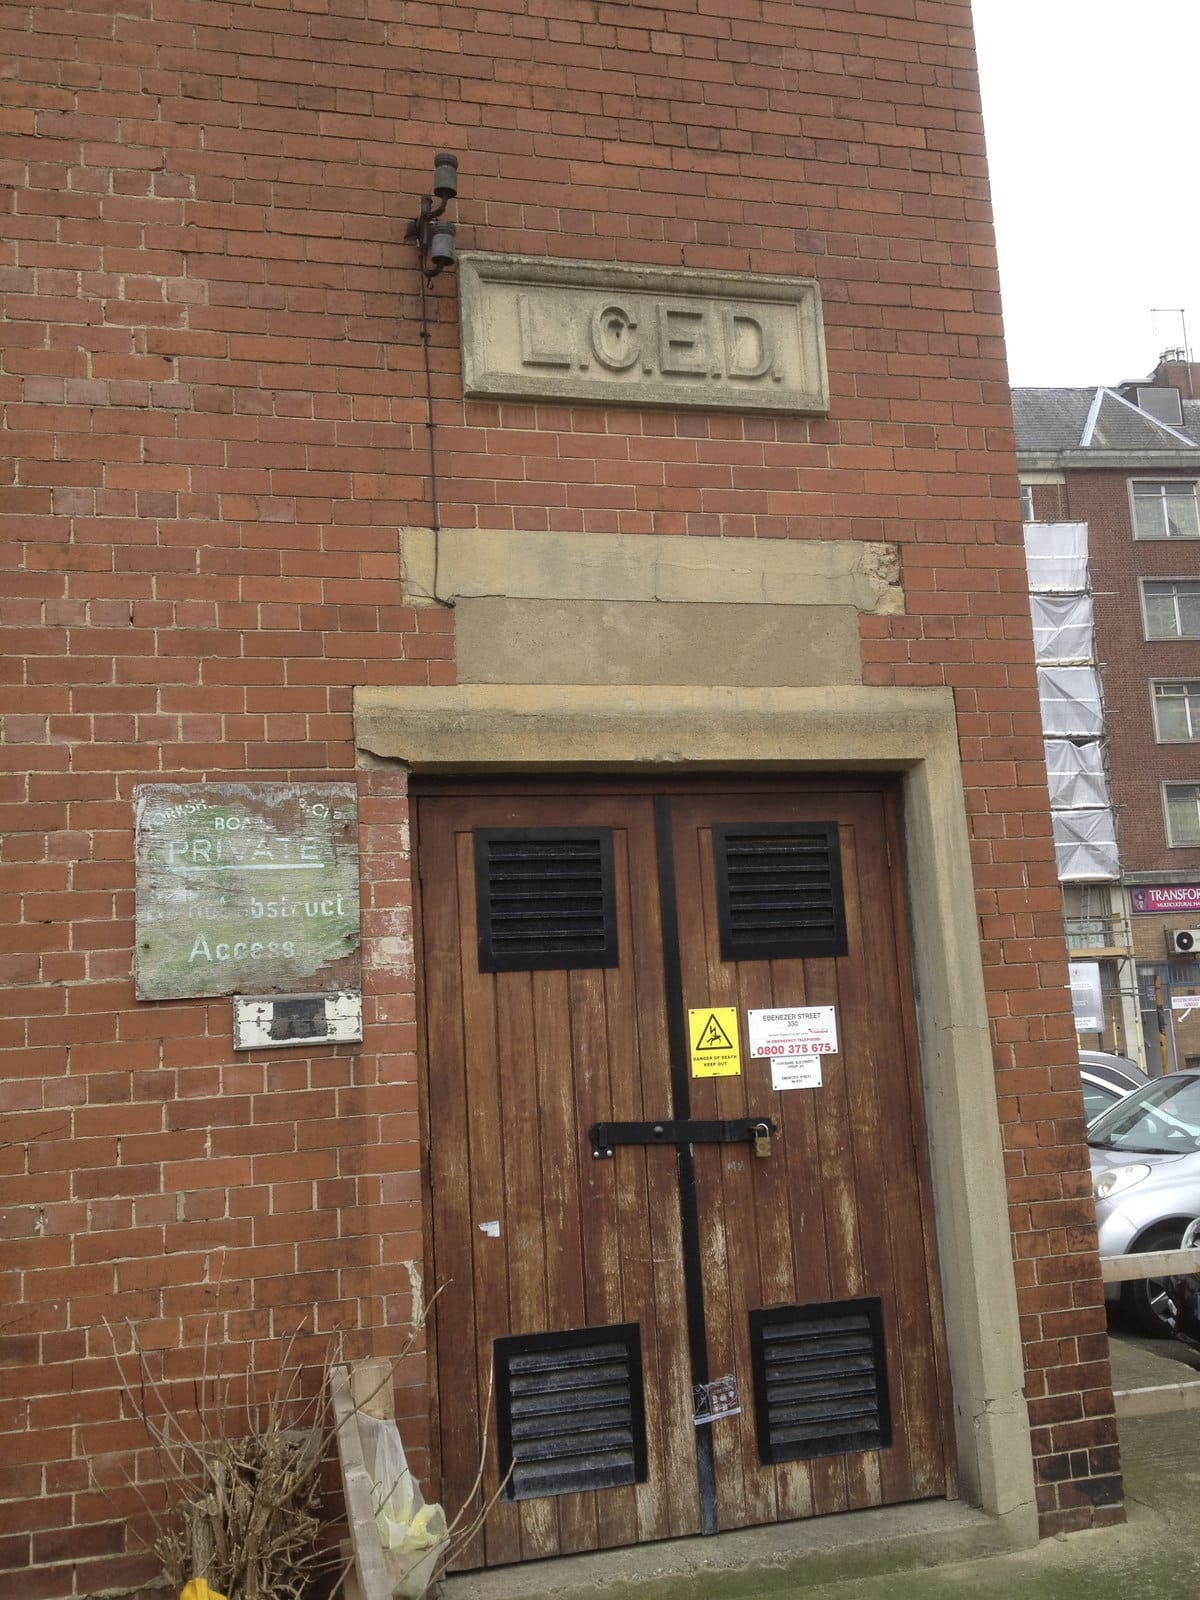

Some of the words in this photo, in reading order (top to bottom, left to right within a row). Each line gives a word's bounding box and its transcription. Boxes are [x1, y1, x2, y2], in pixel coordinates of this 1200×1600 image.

[167, 836, 320, 864] PRIVATE
[238, 893, 345, 919] bstruct
[188, 933, 295, 962] Access
[762, 1013, 797, 1022] EBENEZER
[797, 1012, 821, 1020] STREET
[757, 1045, 784, 1056] 0800
[788, 1044, 808, 1054] 375
[811, 1043, 831, 1053] 675
